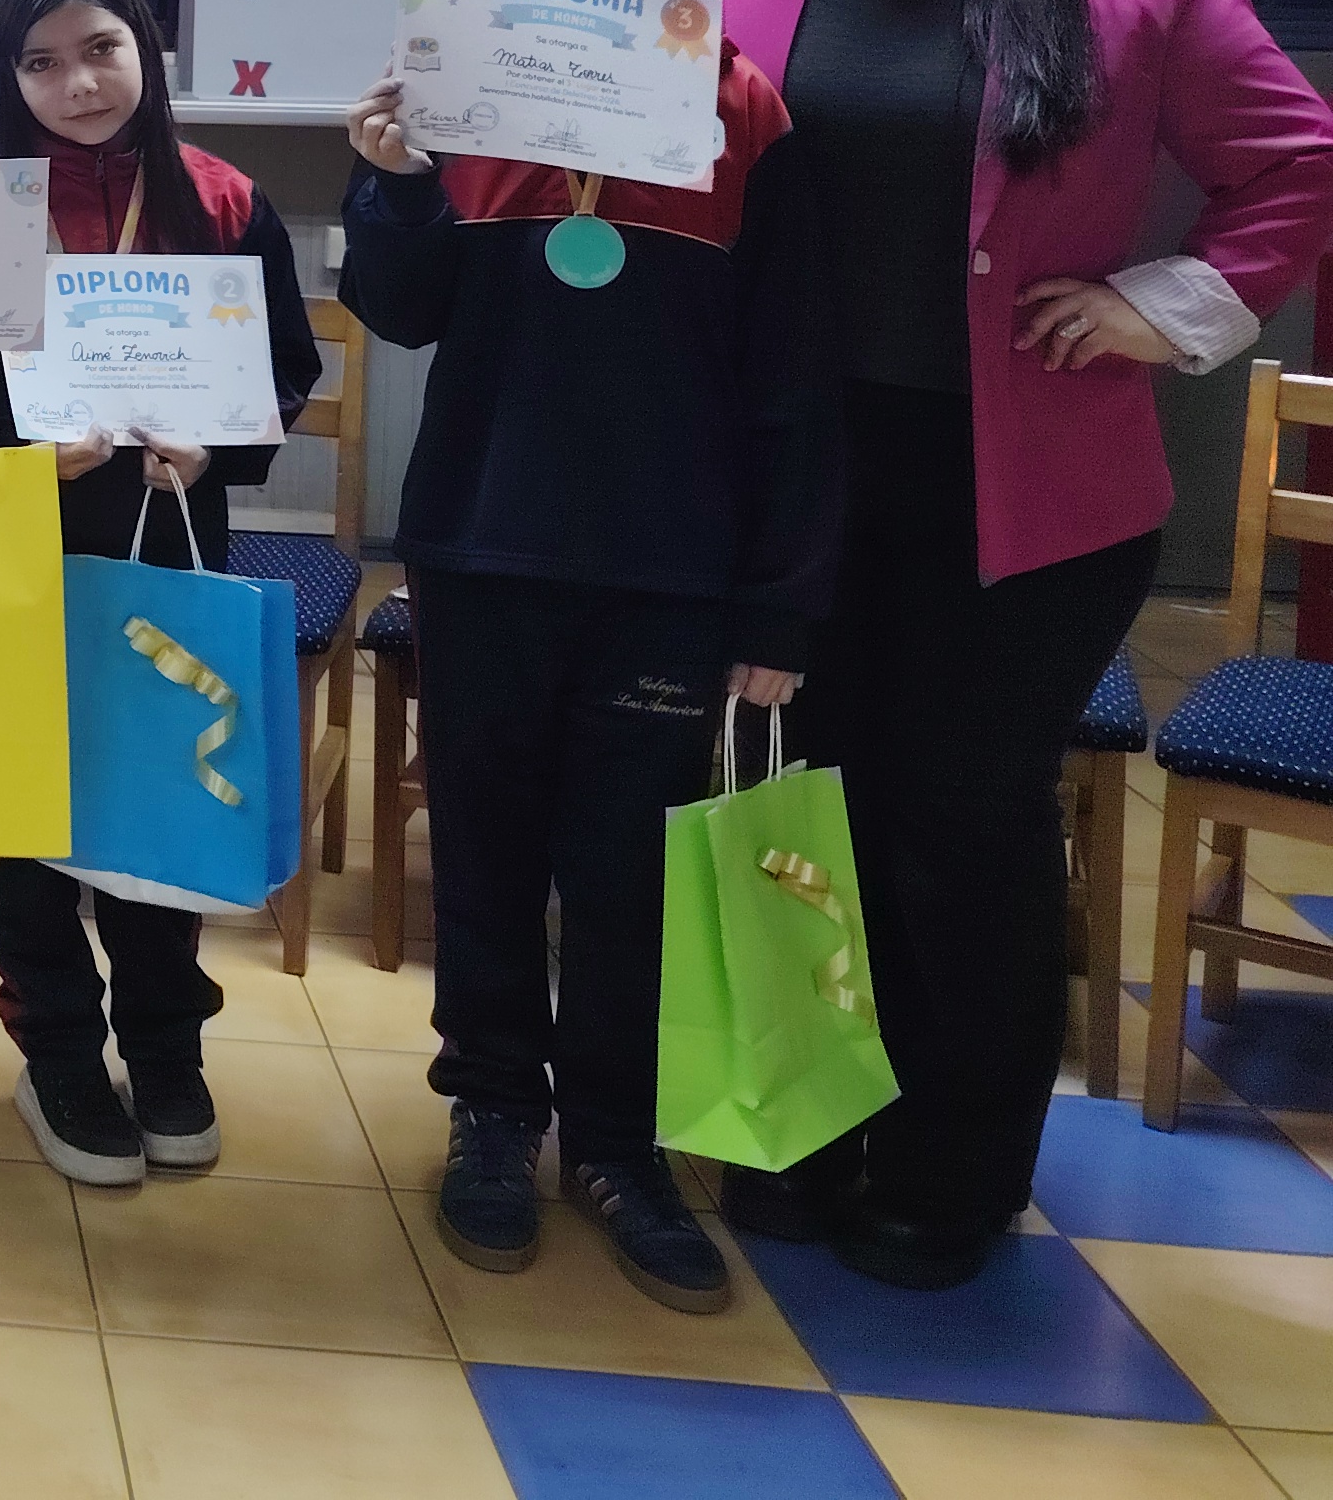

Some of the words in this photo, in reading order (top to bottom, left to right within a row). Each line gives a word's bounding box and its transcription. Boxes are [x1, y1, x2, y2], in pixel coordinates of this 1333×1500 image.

[676, 7, 694, 30] 3
[56, 270, 190, 296] DIPLOMA
[222, 279, 237, 298] 2
